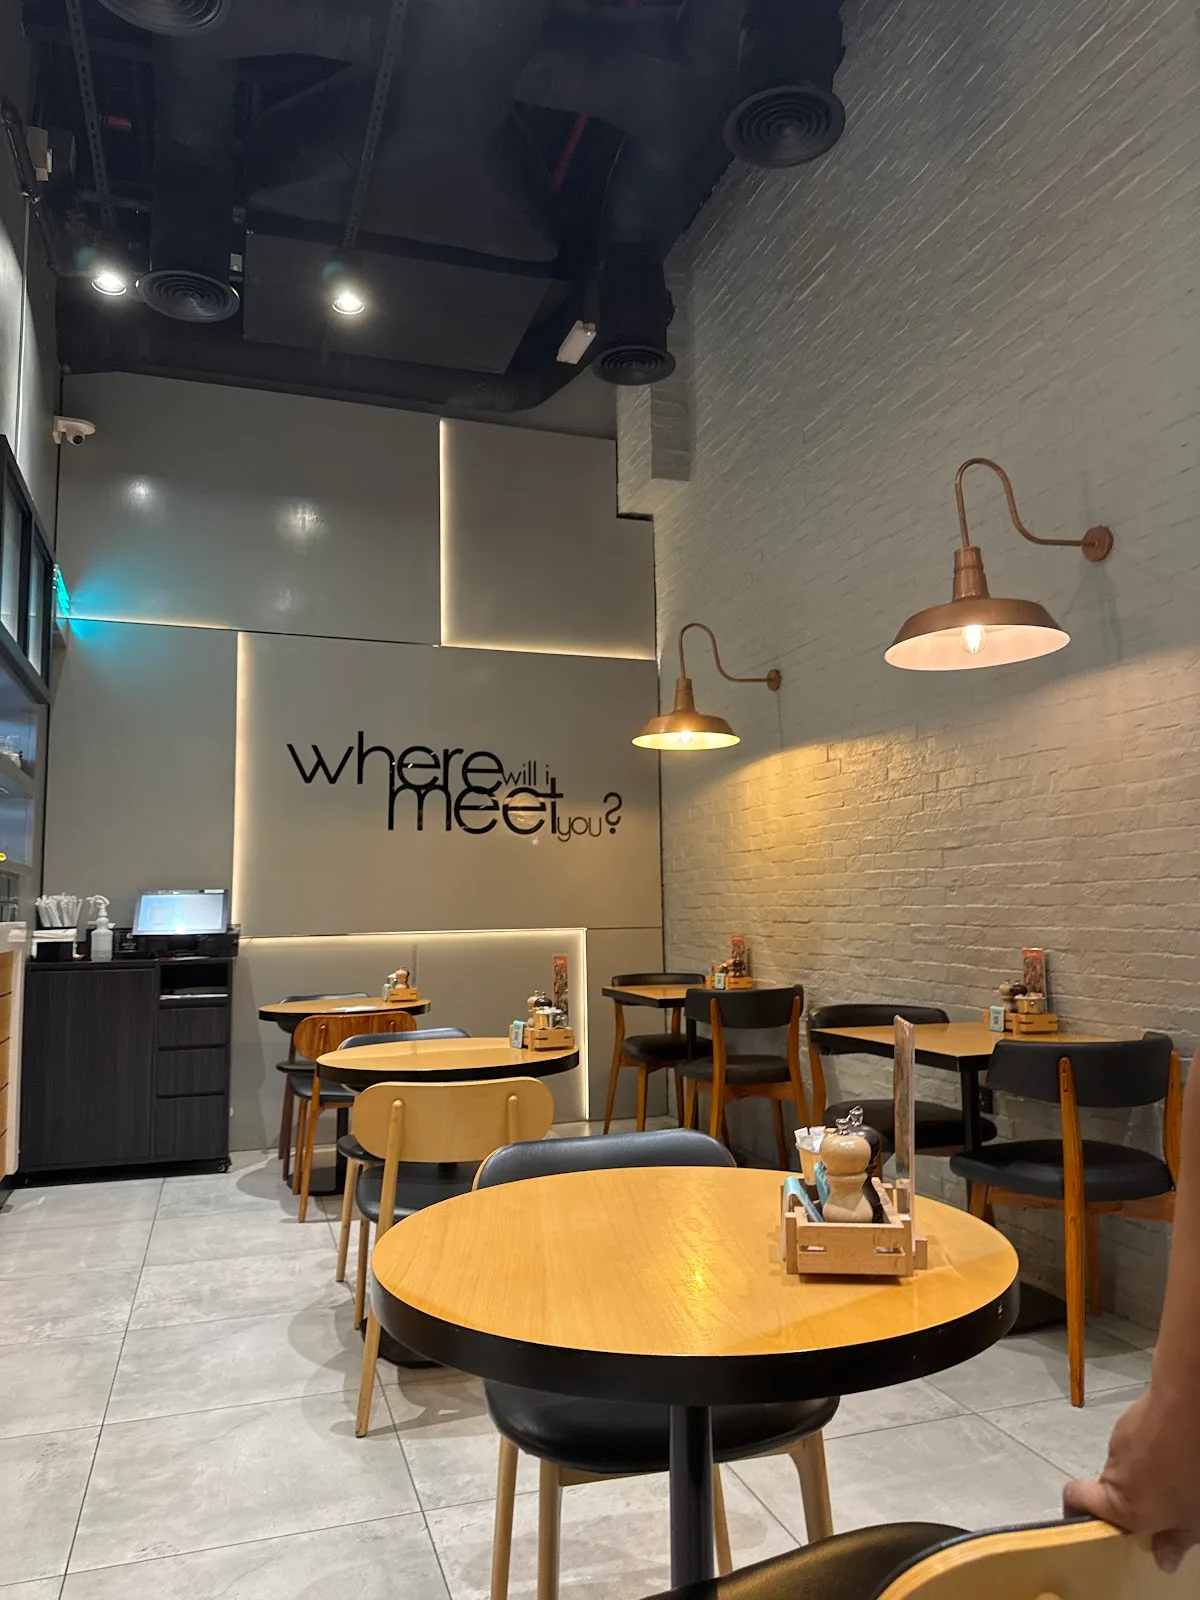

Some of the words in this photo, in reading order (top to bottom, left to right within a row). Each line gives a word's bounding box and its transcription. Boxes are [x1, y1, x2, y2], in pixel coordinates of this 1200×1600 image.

[286, 731, 504, 793] where
[502, 761, 537, 786] will
[545, 764, 550, 786] i
[388, 777, 564, 835] meet
